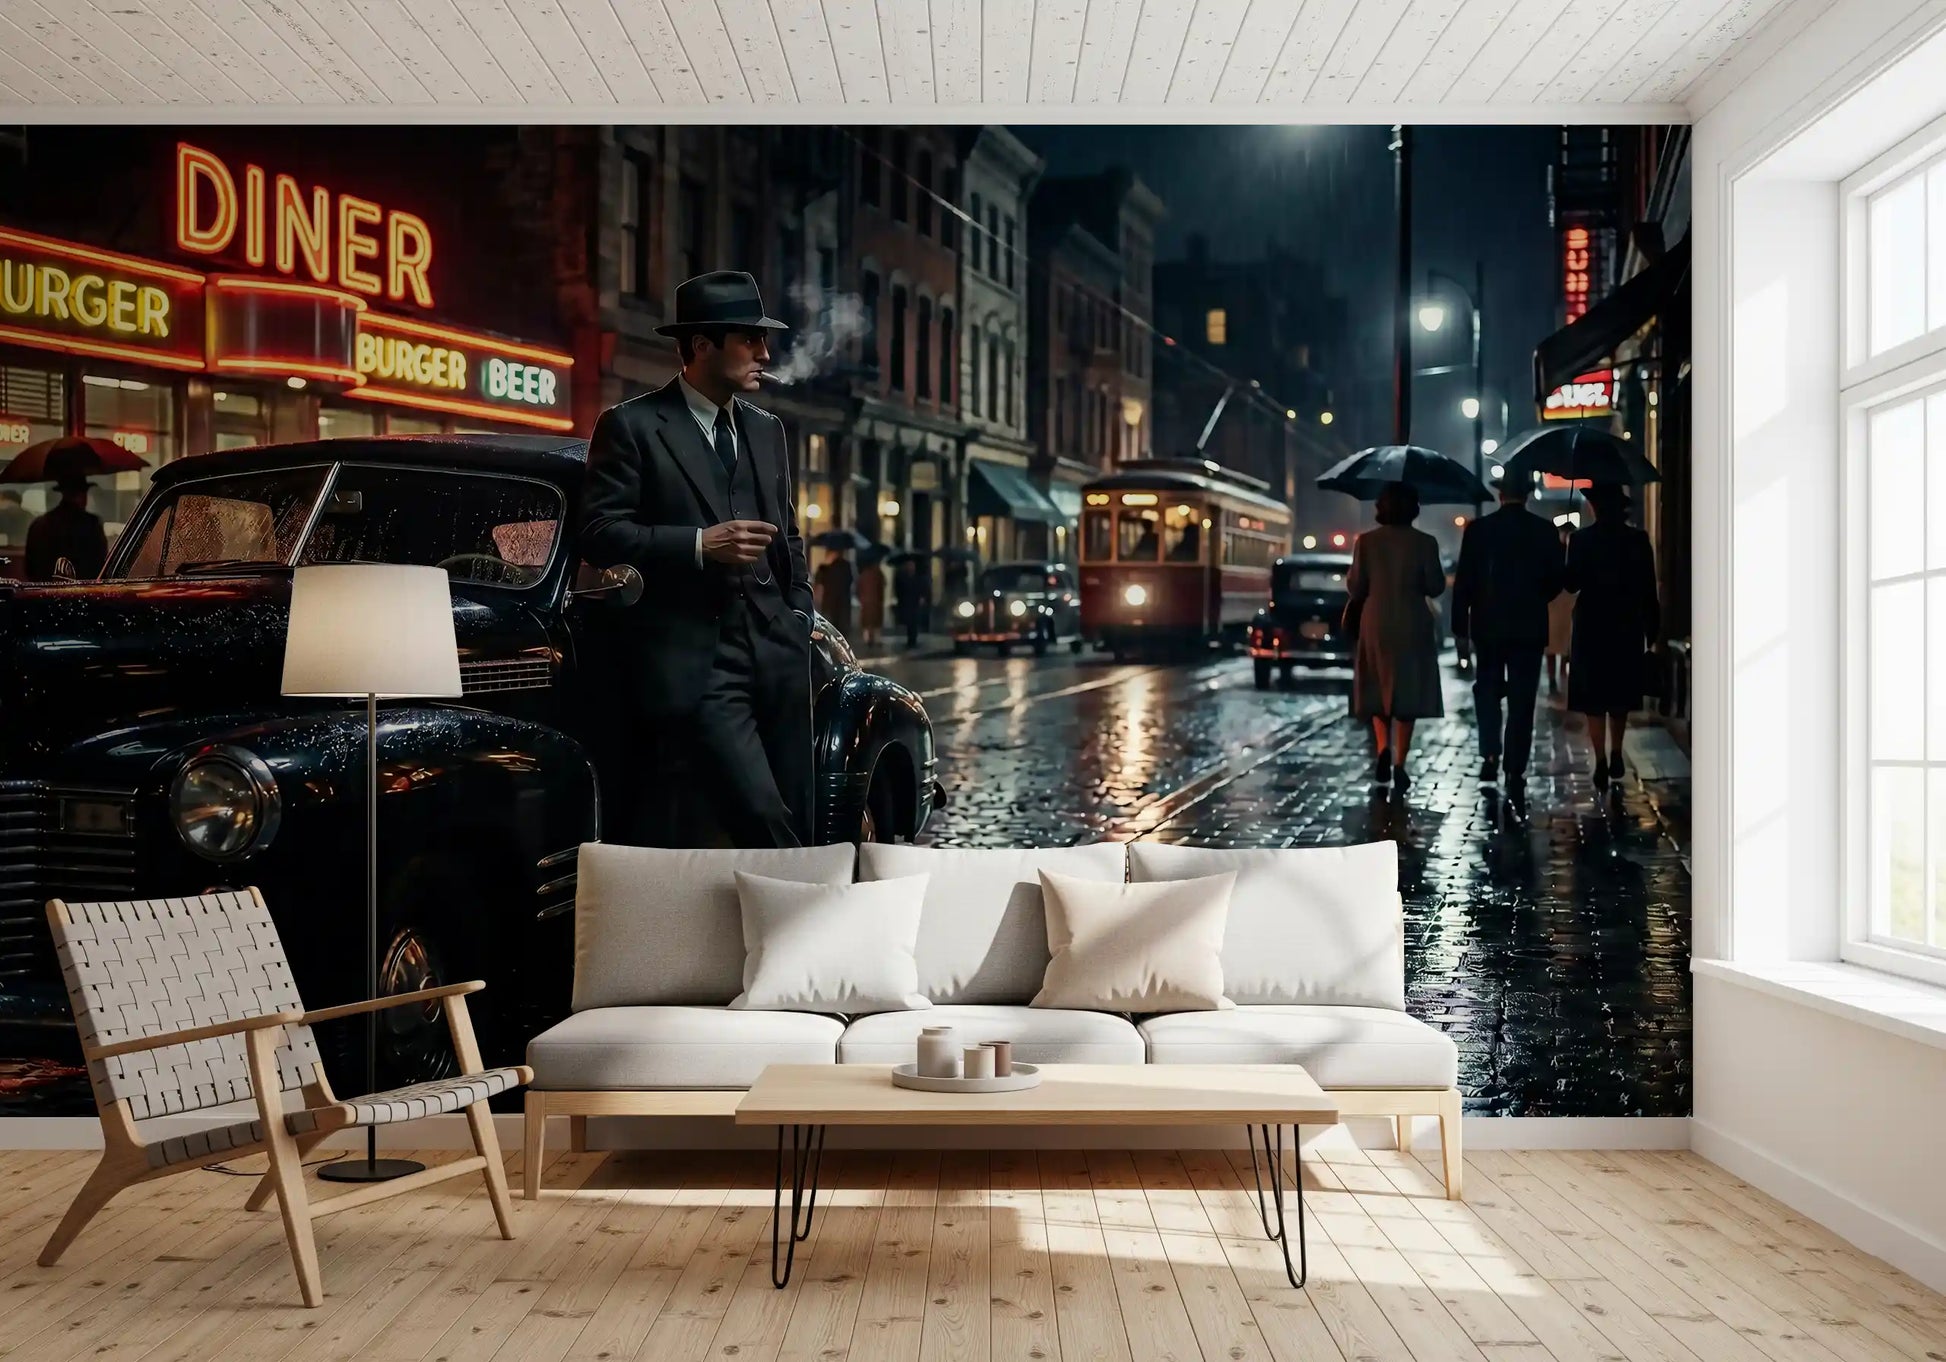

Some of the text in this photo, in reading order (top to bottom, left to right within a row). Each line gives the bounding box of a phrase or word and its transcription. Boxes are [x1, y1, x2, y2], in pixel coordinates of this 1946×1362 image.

[177, 142, 434, 308] DINER
[356, 332, 555, 405] BURGER BEER
